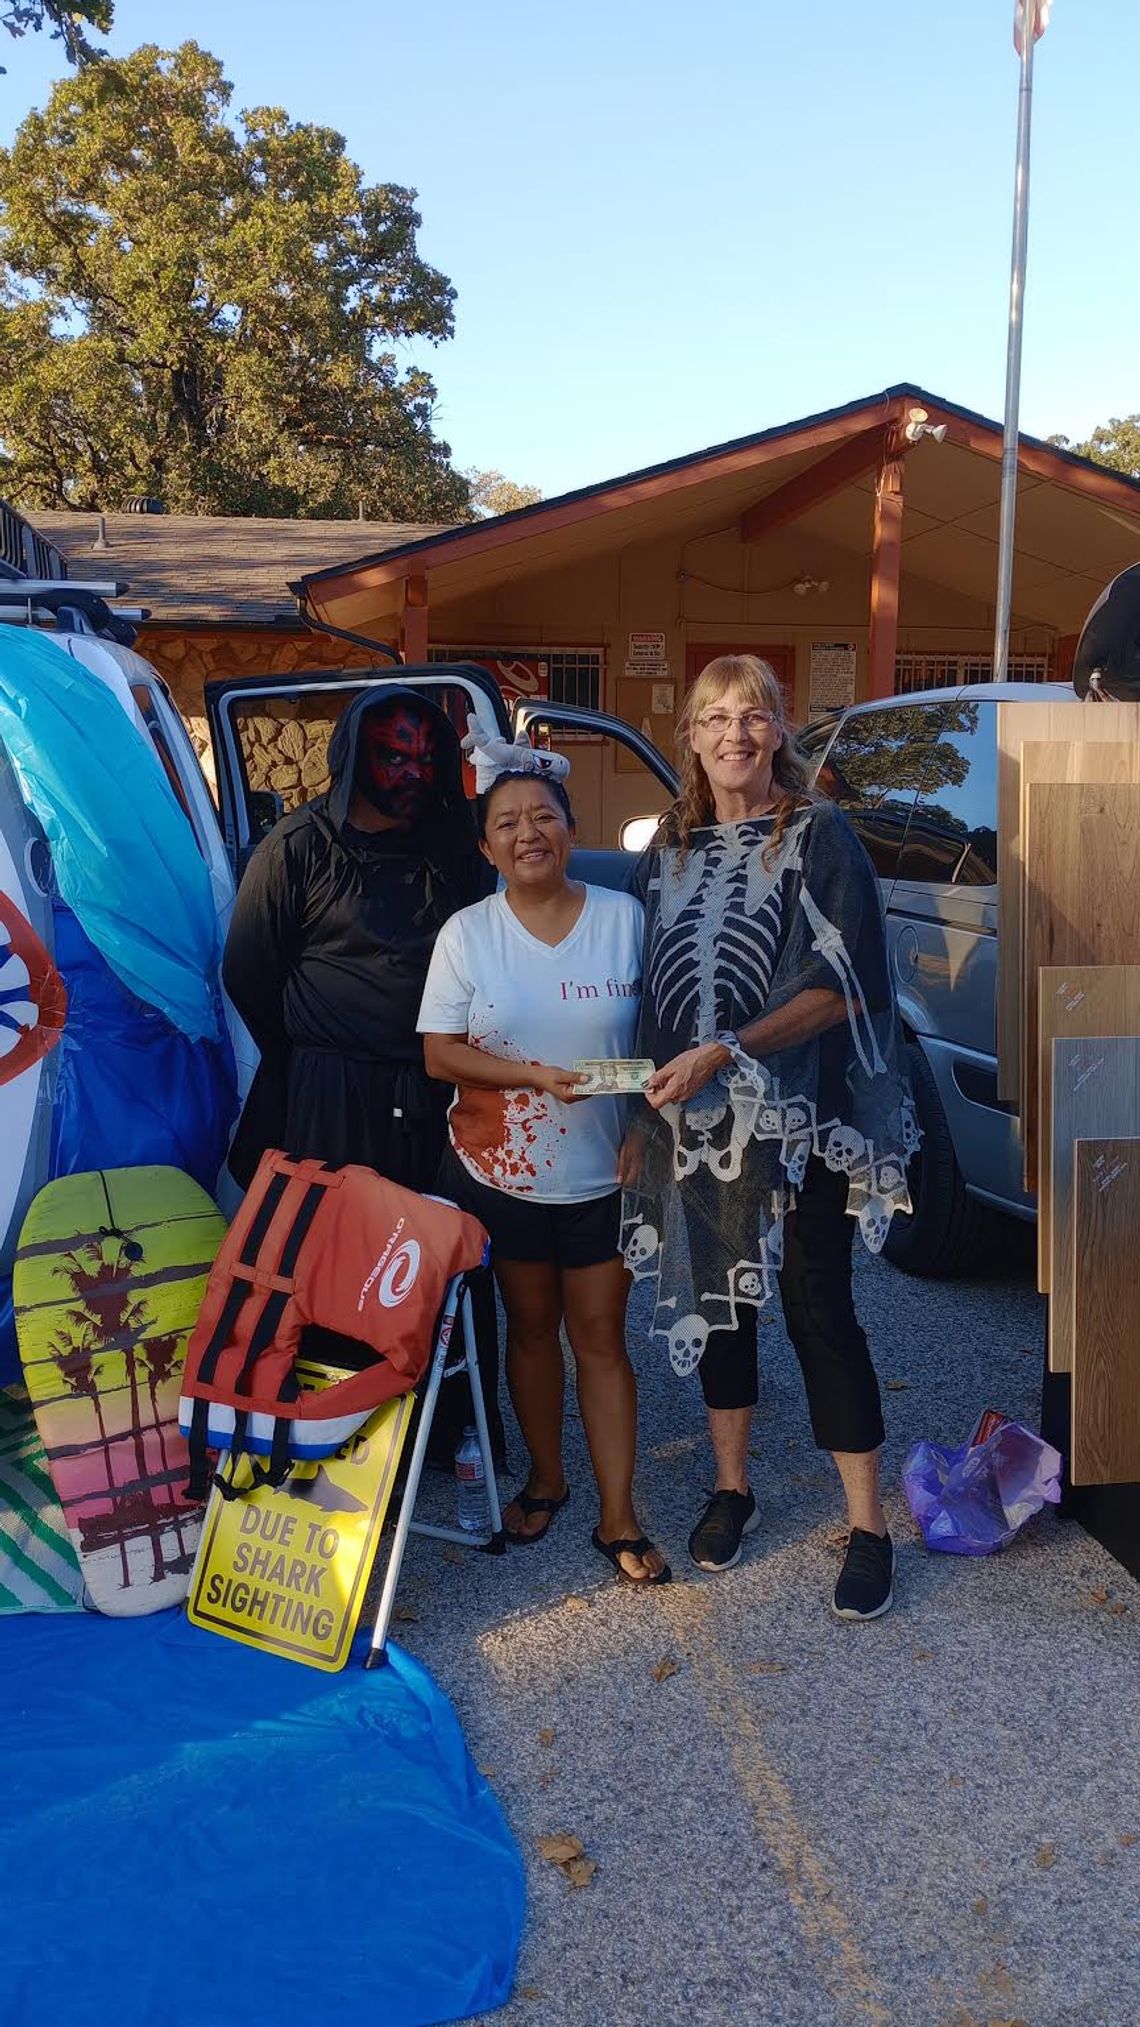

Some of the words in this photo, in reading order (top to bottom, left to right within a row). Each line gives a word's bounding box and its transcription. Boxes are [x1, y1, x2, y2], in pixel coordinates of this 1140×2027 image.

[560, 981, 599, 1000] I'm
[240, 1504, 297, 1547] DUE
[305, 1523, 339, 1559] TO
[232, 1542, 327, 1598] SHARK
[206, 1573, 335, 1641] SIGHTING
